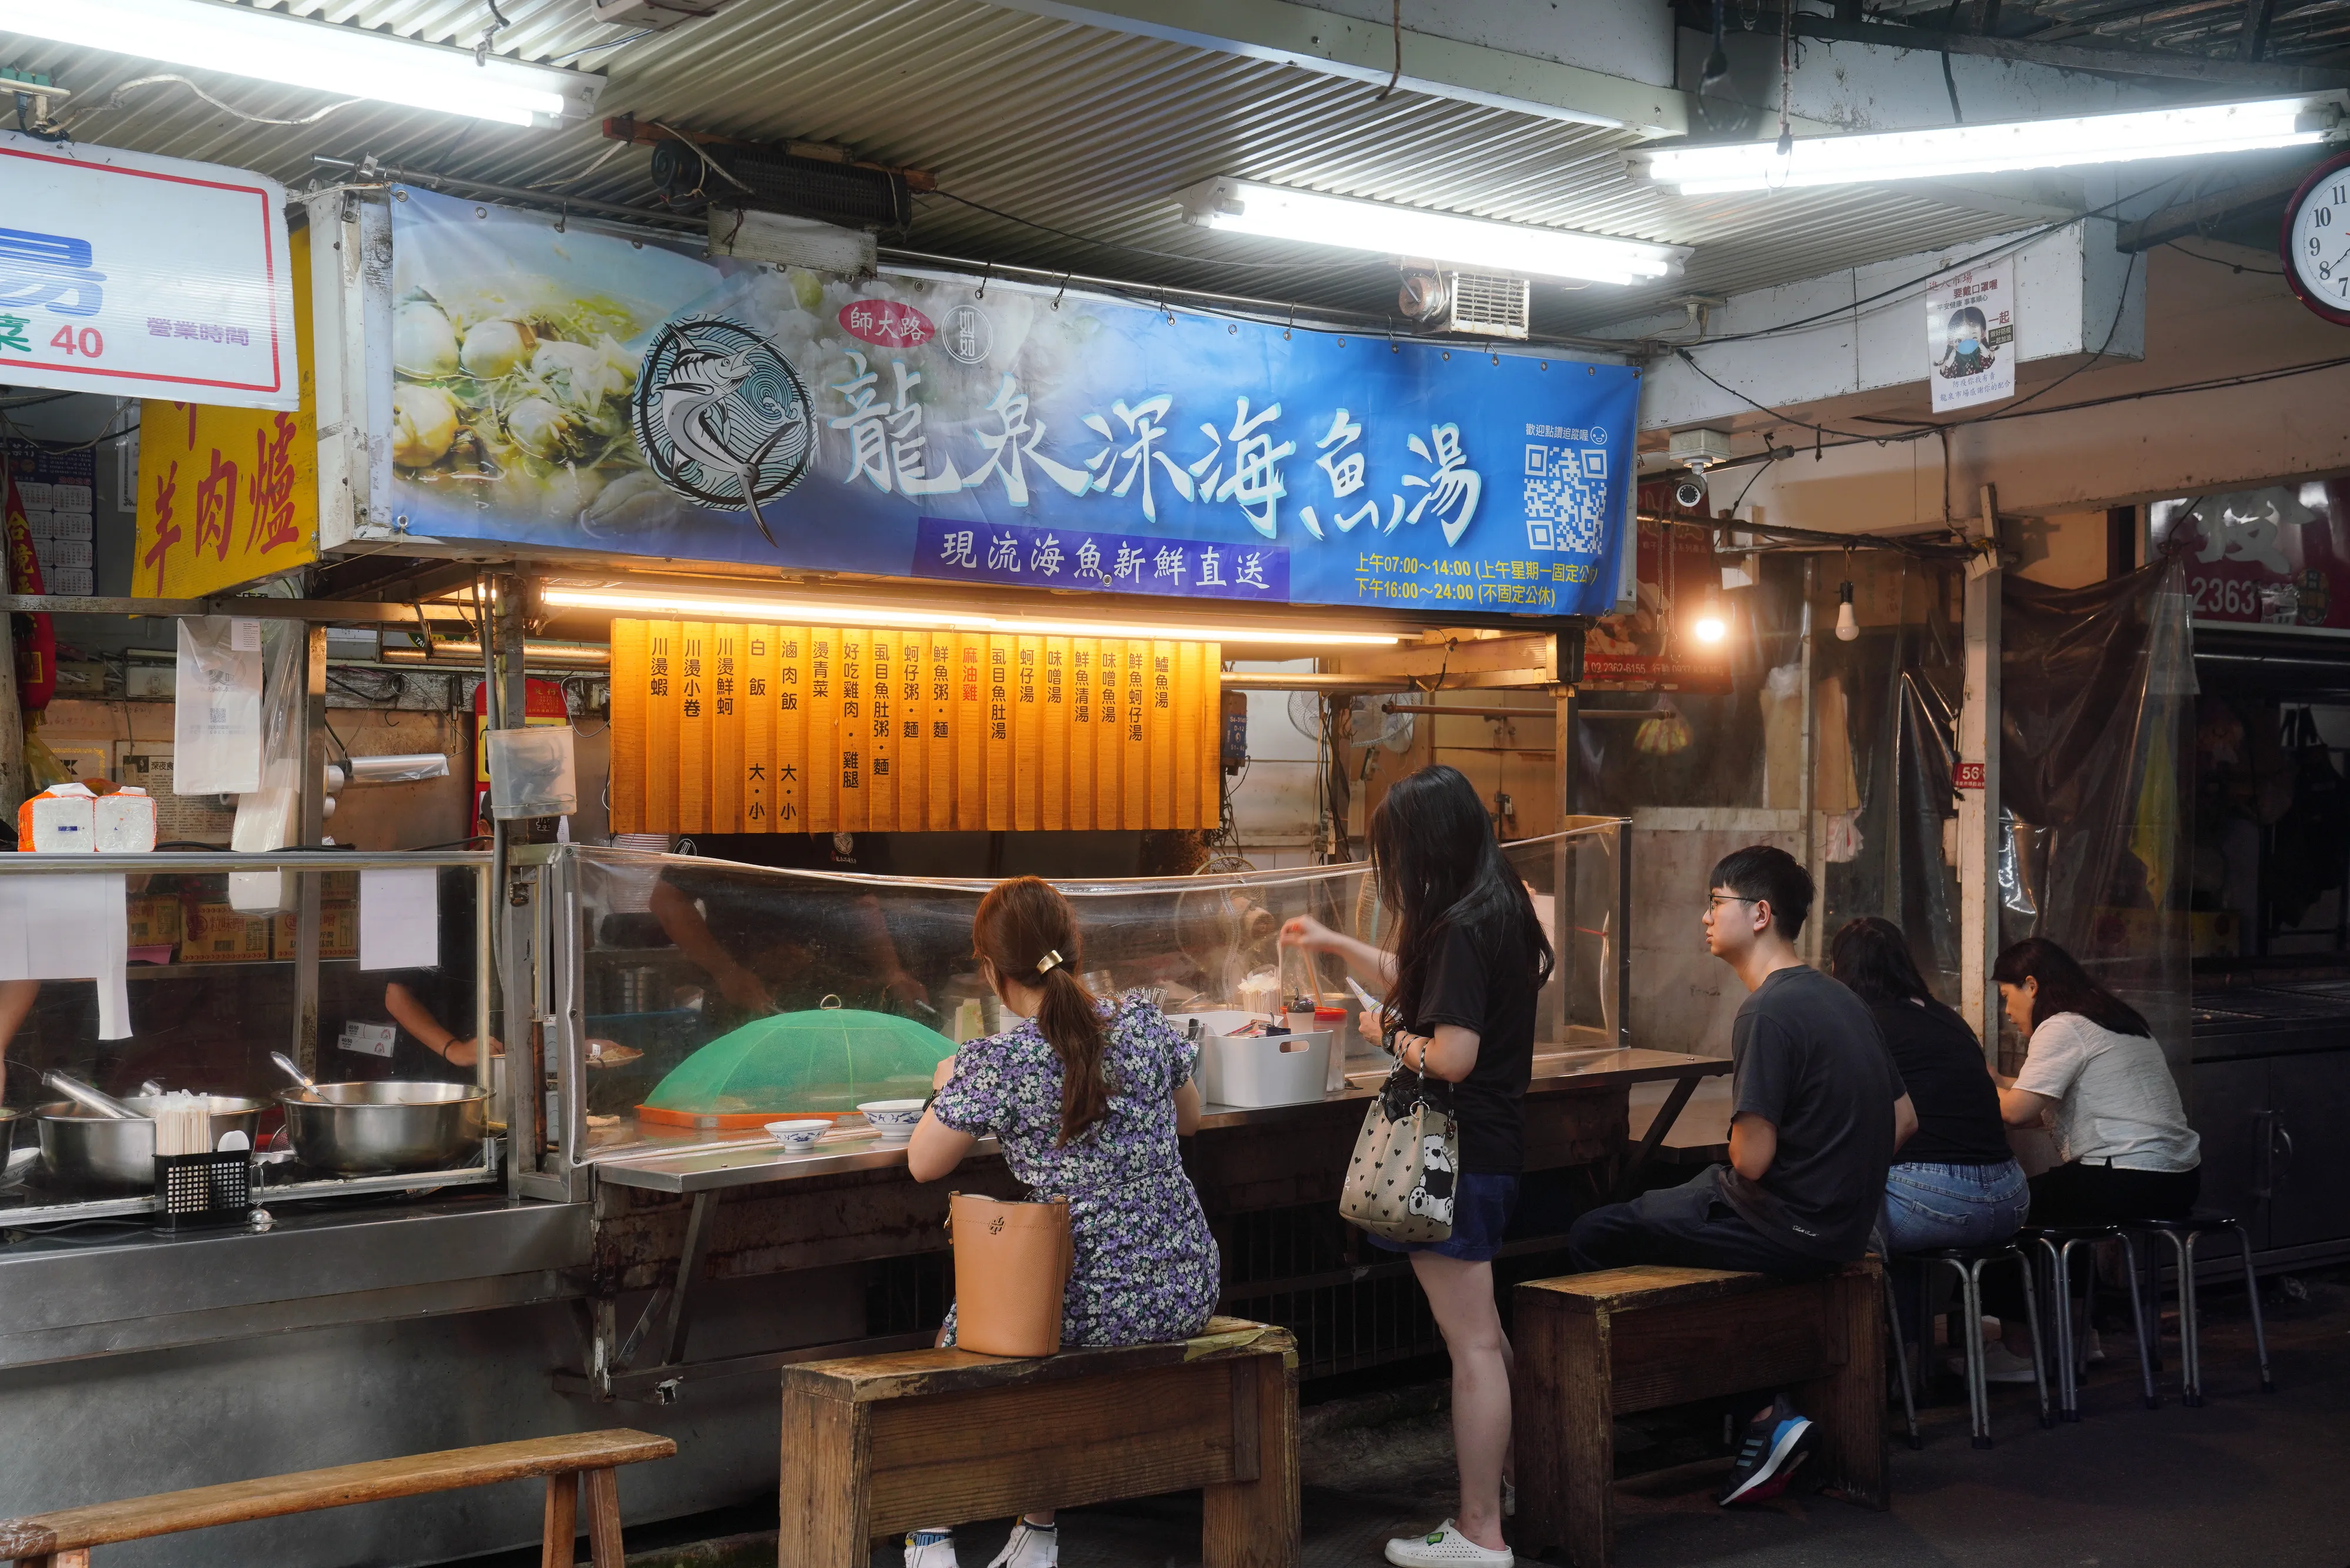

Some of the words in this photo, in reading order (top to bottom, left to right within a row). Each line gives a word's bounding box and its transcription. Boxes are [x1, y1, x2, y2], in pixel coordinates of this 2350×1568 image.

[2332, 184, 2347, 205] 11
[2314, 207, 2331, 228] 10
[2309, 237, 2321, 256] 9
[1953, 279, 1998, 299] 要戴口罩喔
[2319, 261, 2331, 280] 8
[2338, 277, 2348, 297] 7
[851, 300, 927, 342] 師大路
[1937, 300, 1963, 311] 平安健康
[1988, 310, 2010, 325] 一起
[51, 324, 103, 358] 40
[147, 317, 250, 347] 營業時間
[1990, 326, 2011, 337] 做好防疫
[1990, 335, 2012, 344] 一起加油
[1940, 380, 2011, 402] 龍泉市場感謝你的配合
[1952, 371, 1996, 388] 防疫你我有責
[827, 349, 1482, 548] 龍泉深海魚湯
[145, 411, 299, 597] 羊肉爐
[940, 530, 1271, 590] 現流海魚新鮮直送
[2191, 577, 2255, 615] 2363
[650, 637, 669, 697] 川燙蝦
[683, 639, 701, 718] 川燙小卷
[716, 637, 734, 716] 川燙鮮蚵
[781, 640, 798, 711] 滷肉飯
[813, 641, 830, 699] 燙青菜
[962, 647, 978, 702] 麻油雞
[1019, 649, 1035, 703] 蚵仔湯
[1048, 650, 1062, 704] 味噌湯
[1075, 651, 1090, 723] 鮮魚清湯
[1102, 653, 1116, 723] 味噌魚湯
[1154, 656, 1169, 709] 鱸魚湯
[991, 648, 1006, 740] 虱目魚肚湯
[1128, 653, 1143, 741] 鮮魚蚵仔湯
[1962, 766, 1979, 780] 56
